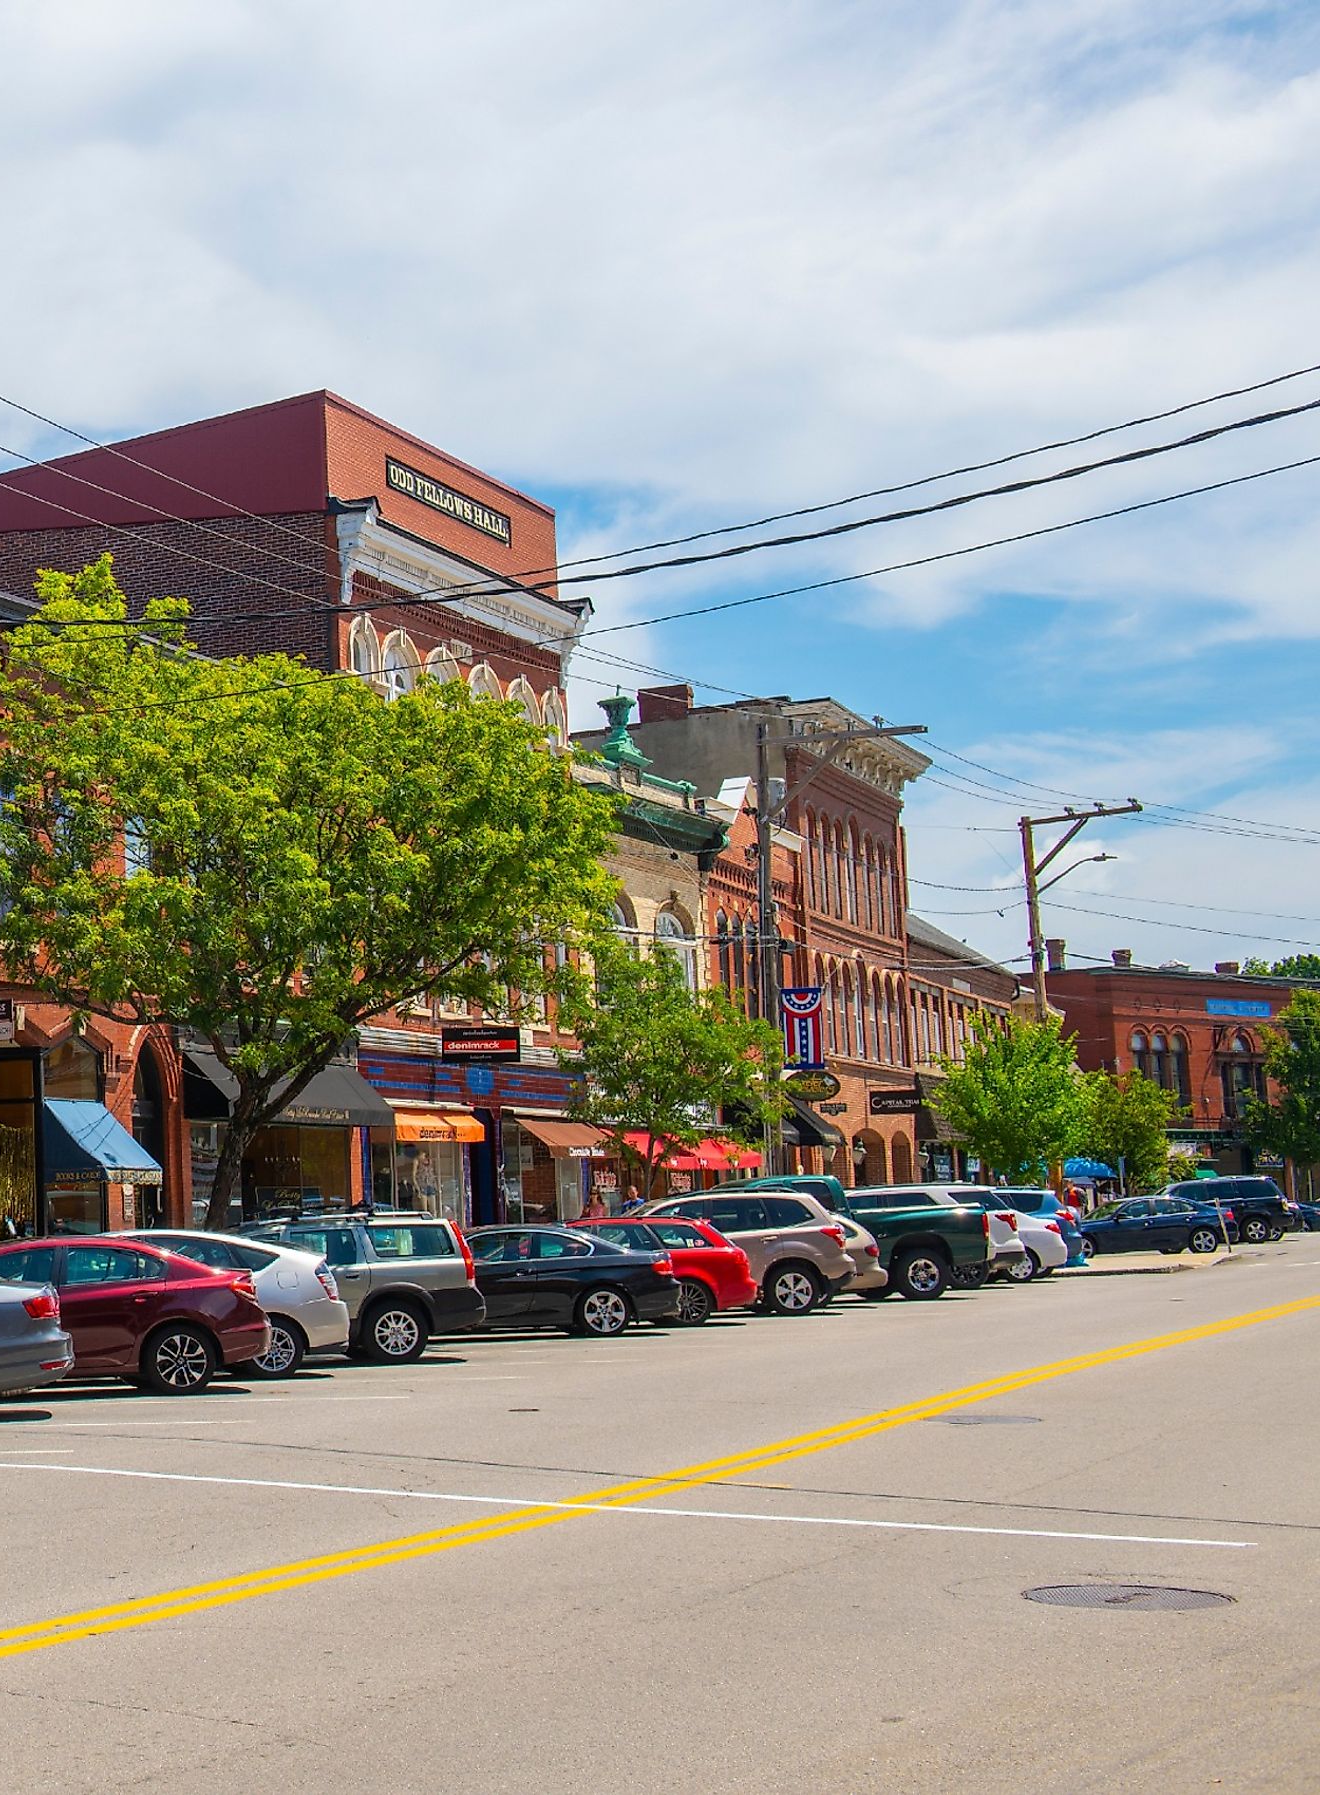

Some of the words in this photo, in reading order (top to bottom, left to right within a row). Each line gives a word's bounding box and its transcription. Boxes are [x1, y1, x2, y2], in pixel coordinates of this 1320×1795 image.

[390, 465, 415, 493] ODD
[415, 477, 473, 521] FELLOWS
[447, 1040, 500, 1051] denimrack
